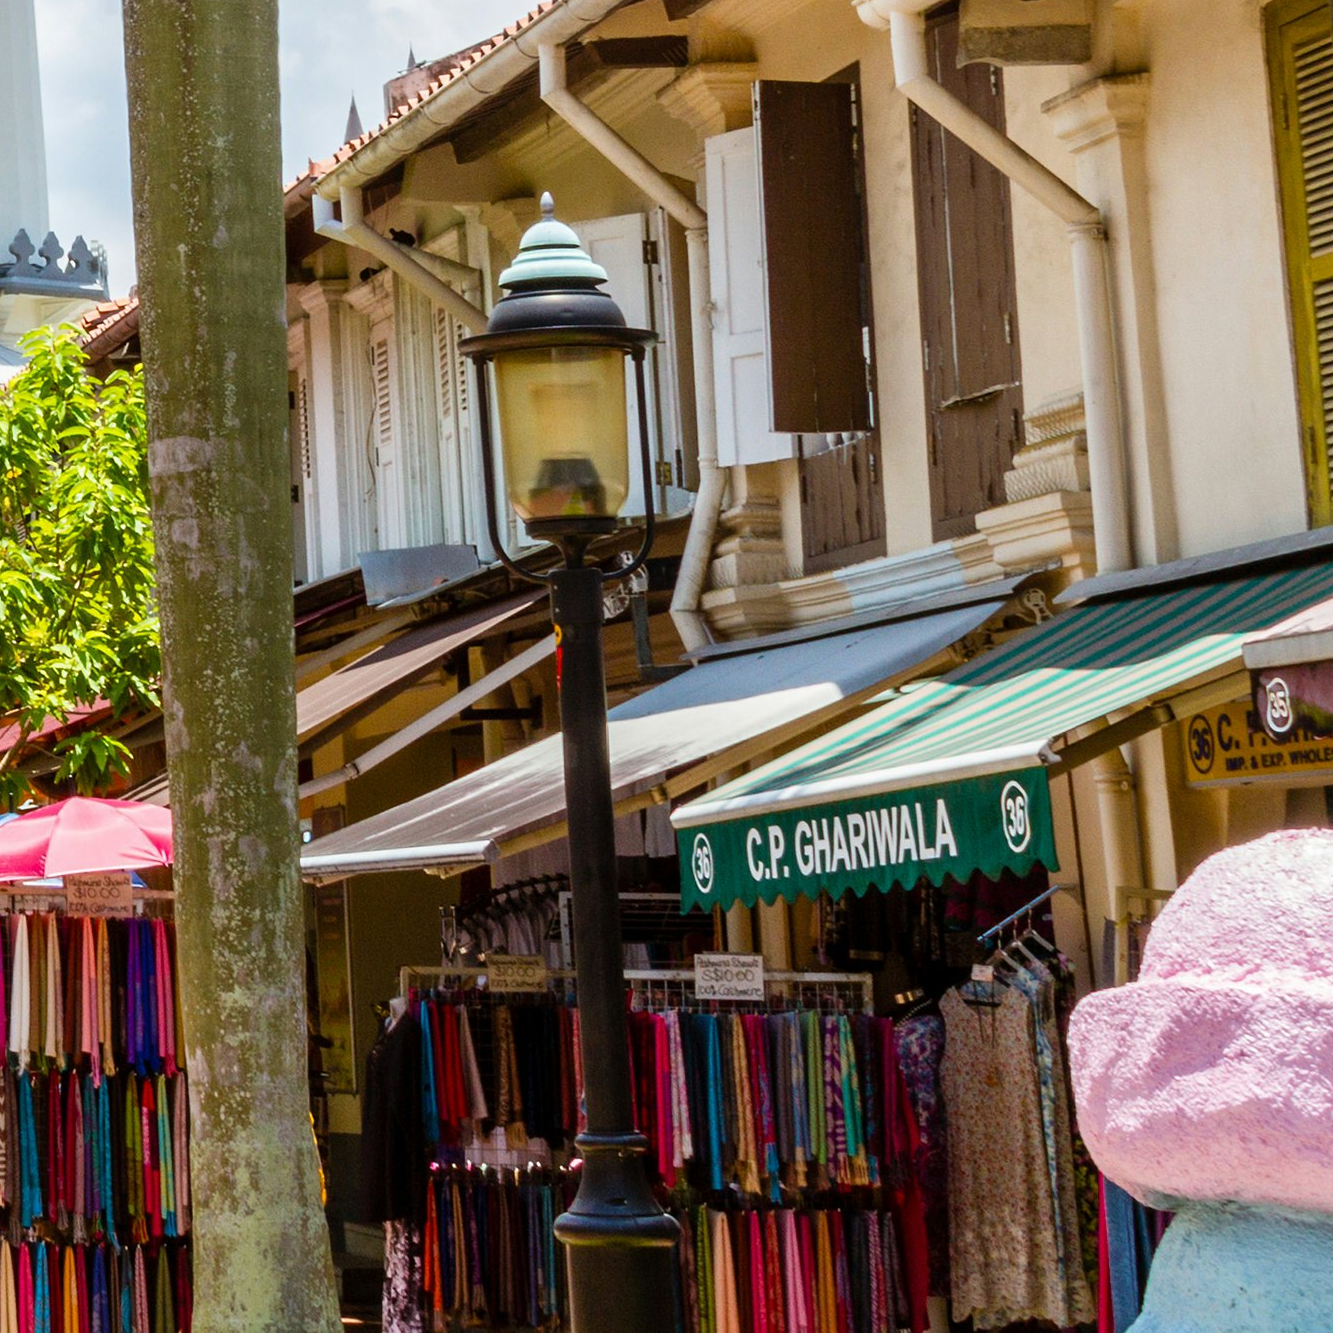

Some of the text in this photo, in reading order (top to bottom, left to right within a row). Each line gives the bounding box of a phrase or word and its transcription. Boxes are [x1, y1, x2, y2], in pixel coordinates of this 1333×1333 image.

[1269, 691, 1288, 719] 35
[1192, 727, 1211, 761] 36
[1217, 713, 1240, 752] C.
[1225, 756, 1248, 772] IMP.
[1250, 755, 1259, 769] &
[1261, 752, 1287, 768] EXP.
[696, 794, 1026, 882] 36 C.P. GHARIWALA 36
[718, 984, 764, 997] Cashmere
